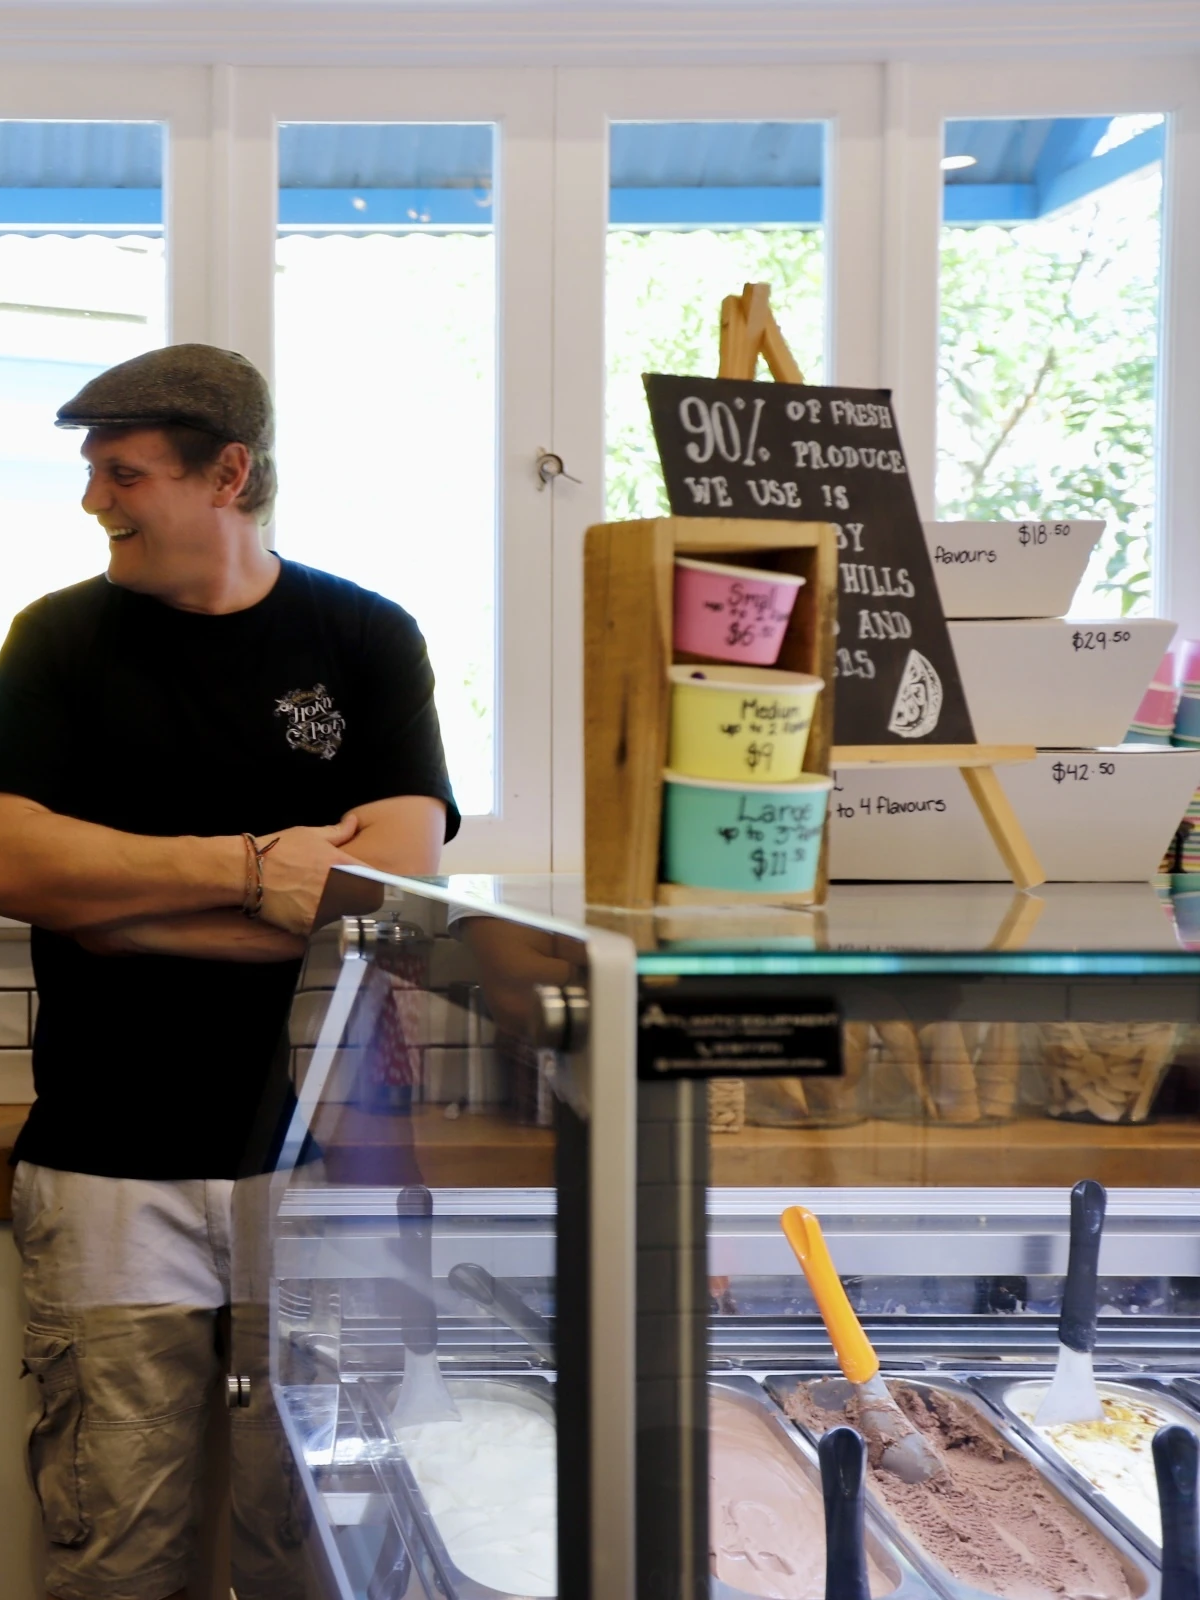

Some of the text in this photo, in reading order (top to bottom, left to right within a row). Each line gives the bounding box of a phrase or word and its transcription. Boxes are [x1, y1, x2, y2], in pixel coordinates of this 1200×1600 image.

[679, 395, 893, 467] 90% OF FRESH
[791, 440, 907, 475] PRODUCE
[684, 476, 733, 508] WE
[746, 478, 802, 508] USE
[1017, 523, 1071, 547] $18.50
[934, 545, 998, 564] flavours
[839, 563, 916, 598] HILLS
[857, 609, 913, 640] AND
[1071, 631, 1131, 652] $29.50
[1051, 761, 1115, 784] $42.50
[836, 796, 947, 818] to 4 flavours
